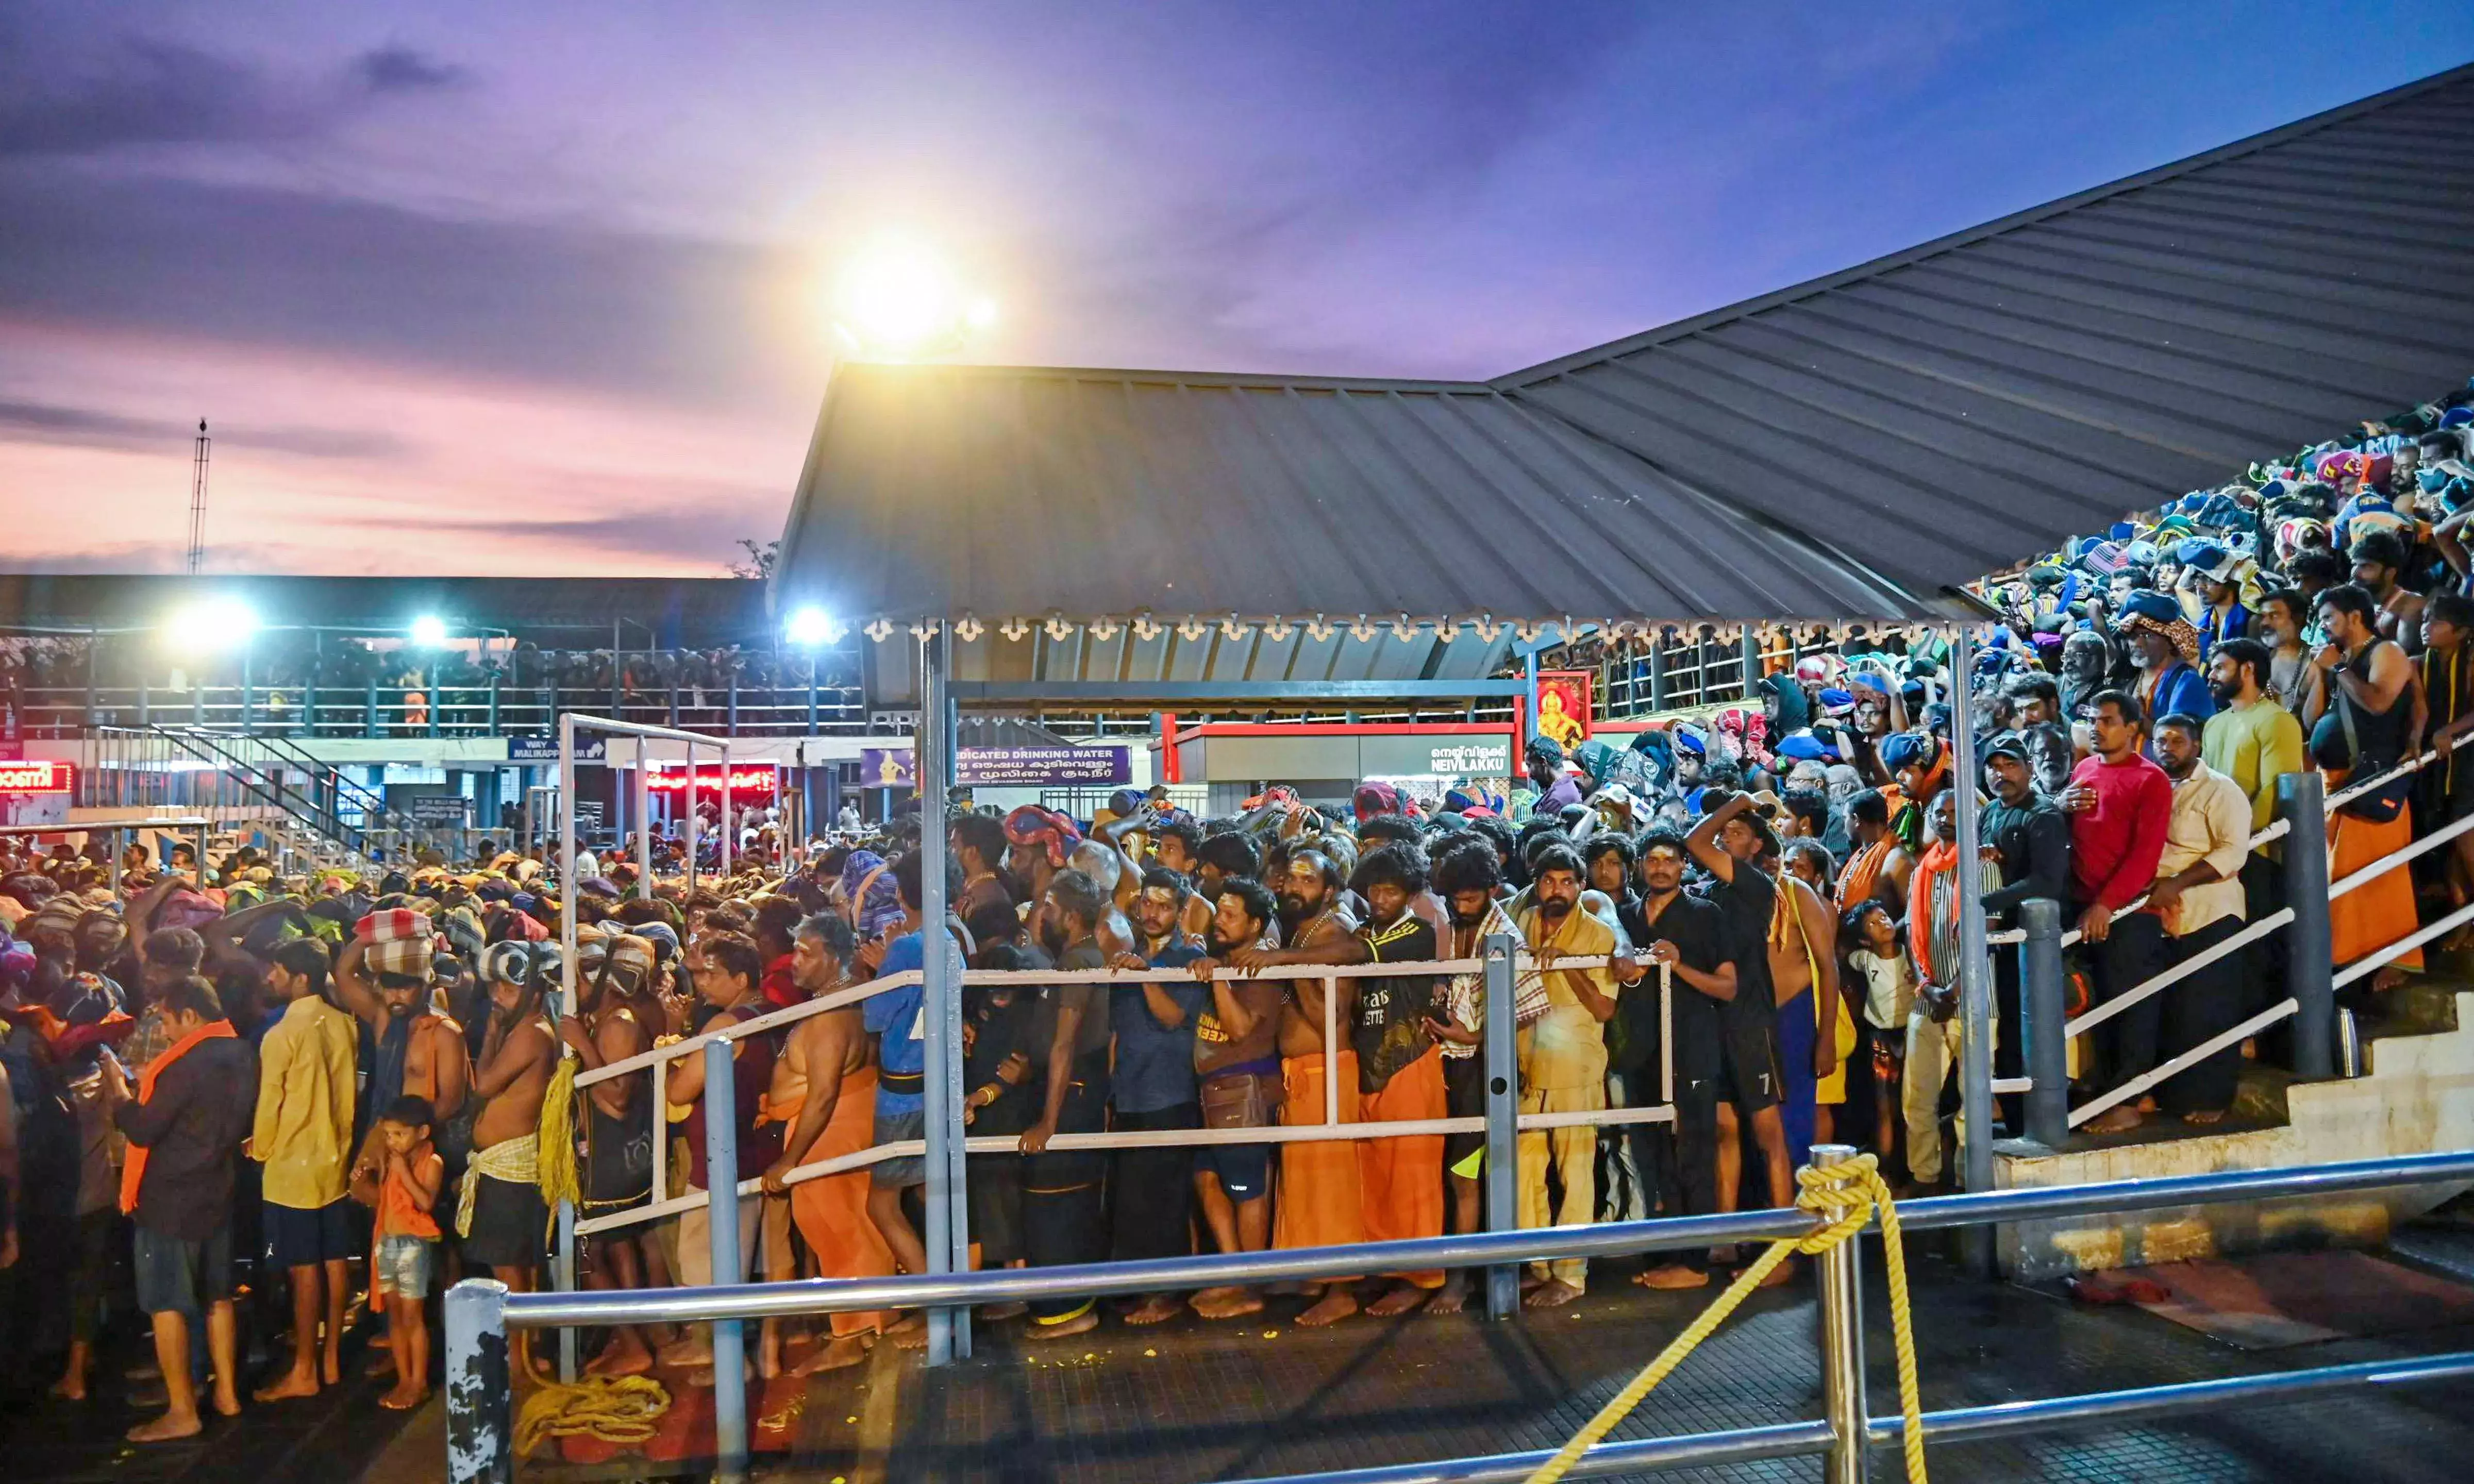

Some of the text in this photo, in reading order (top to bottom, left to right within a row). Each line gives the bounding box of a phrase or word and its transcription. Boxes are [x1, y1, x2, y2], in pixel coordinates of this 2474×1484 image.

[514, 749, 586, 758] MALIKAPPAM
[956, 750, 1113, 760] EDICATED DRINKING WATER
[1431, 758, 1504, 772] NEIVILAKKU
[1871, 970, 1879, 983] 7
[1759, 1073, 1769, 1095] 7
